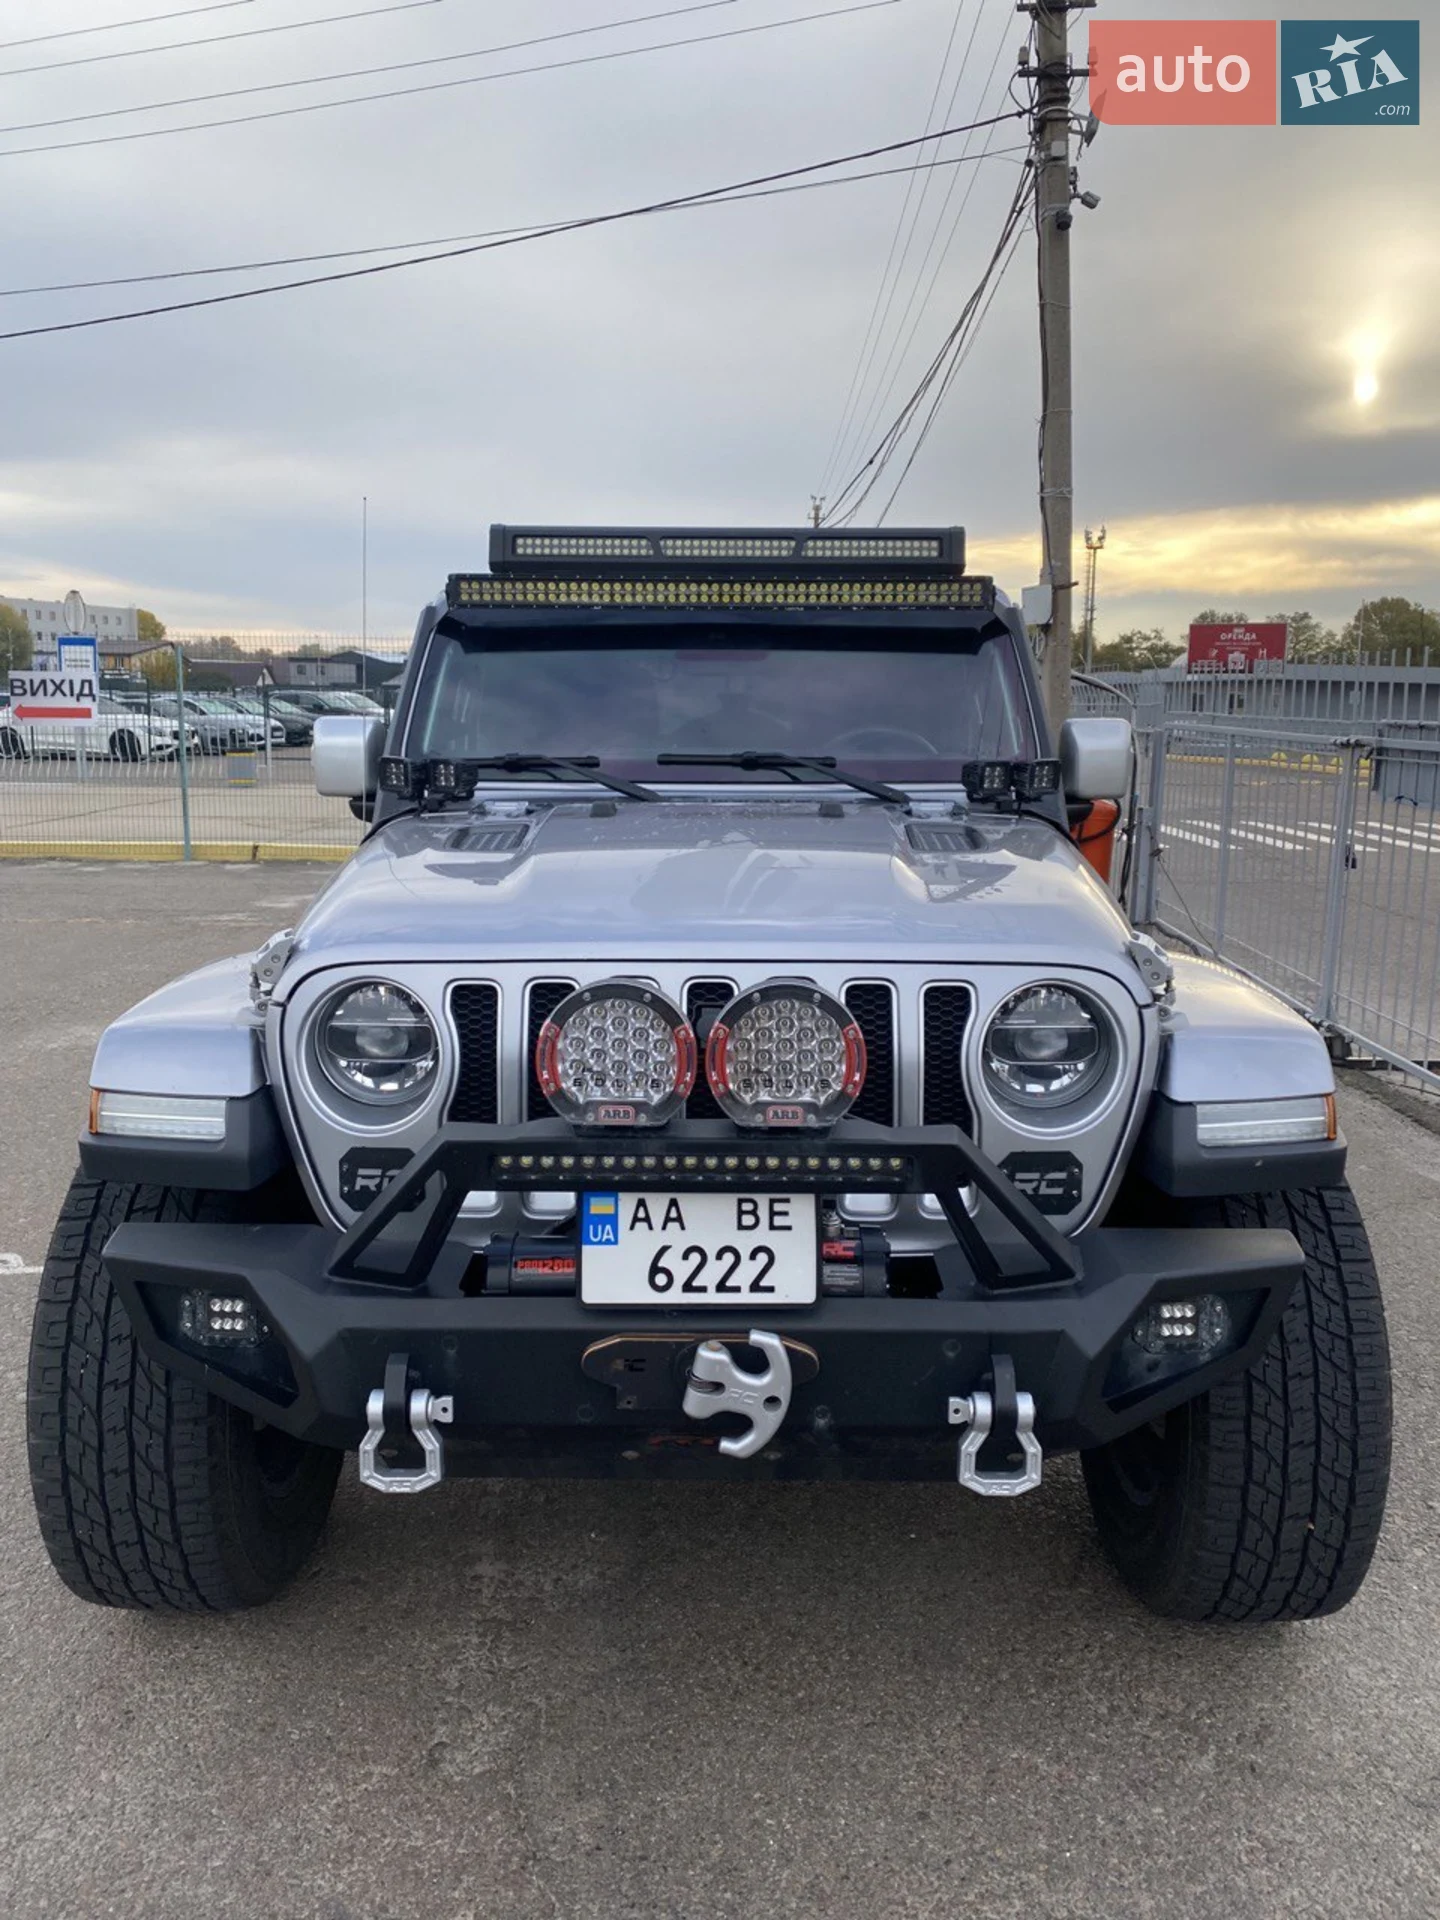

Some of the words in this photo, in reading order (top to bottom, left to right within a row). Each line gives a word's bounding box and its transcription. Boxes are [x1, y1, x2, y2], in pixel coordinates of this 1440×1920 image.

[10, 678, 96, 702] ВИХІД
[602, 1109, 631, 1119] ARB
[771, 1109, 799, 1120] ARB
[629, 1198, 686, 1231] AA
[736, 1198, 793, 1231] BE
[589, 1224, 615, 1242] UA
[648, 1244, 776, 1294] 6222
